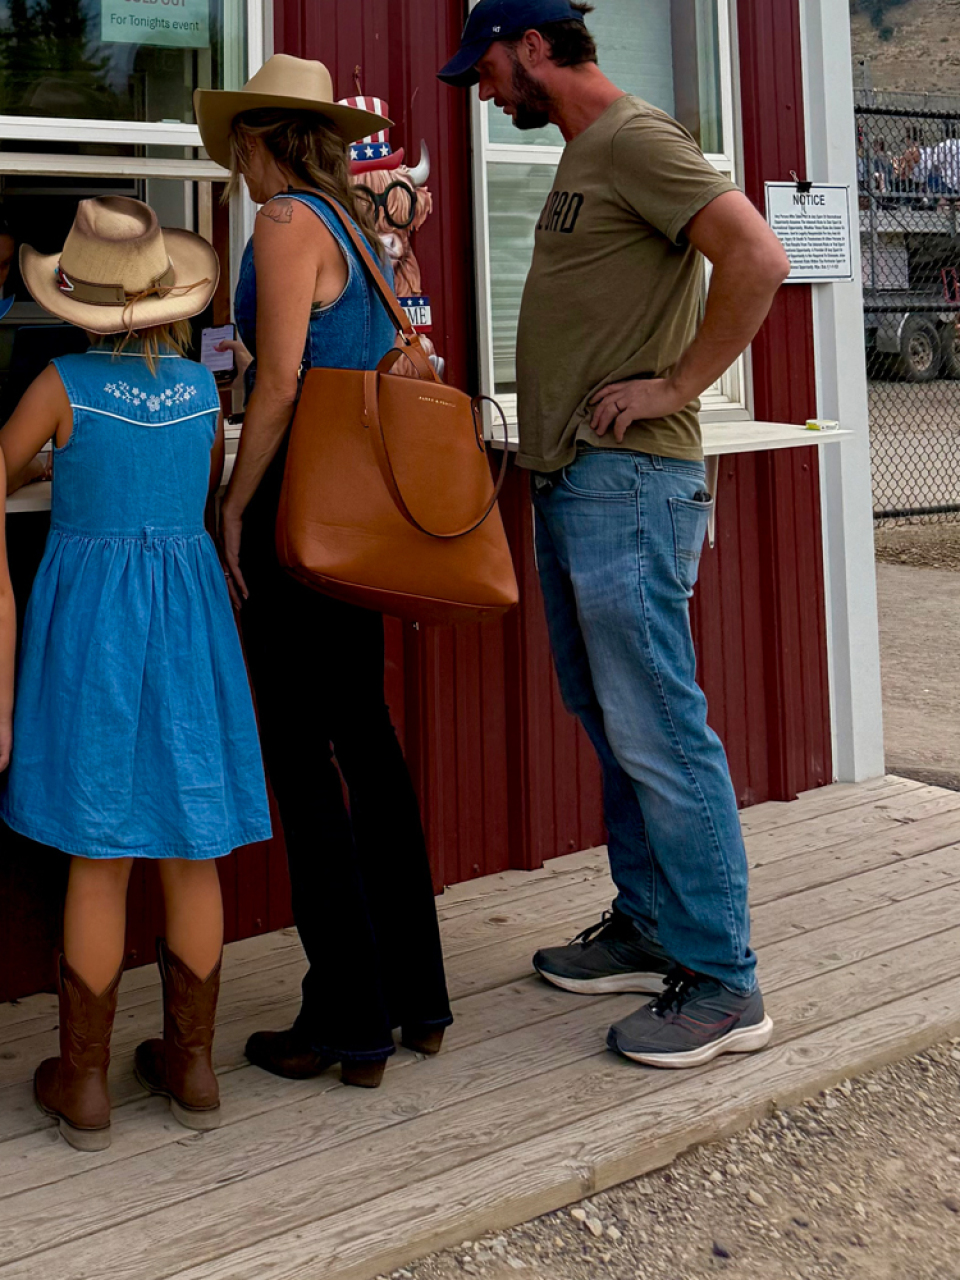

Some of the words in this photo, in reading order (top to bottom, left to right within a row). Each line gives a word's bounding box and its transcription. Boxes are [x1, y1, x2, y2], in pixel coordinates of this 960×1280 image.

[110, 13, 128, 25] For
[128, 14, 170, 30] Tonights
[172, 21, 200, 31] event
[793, 194, 825, 206] NOTICE
